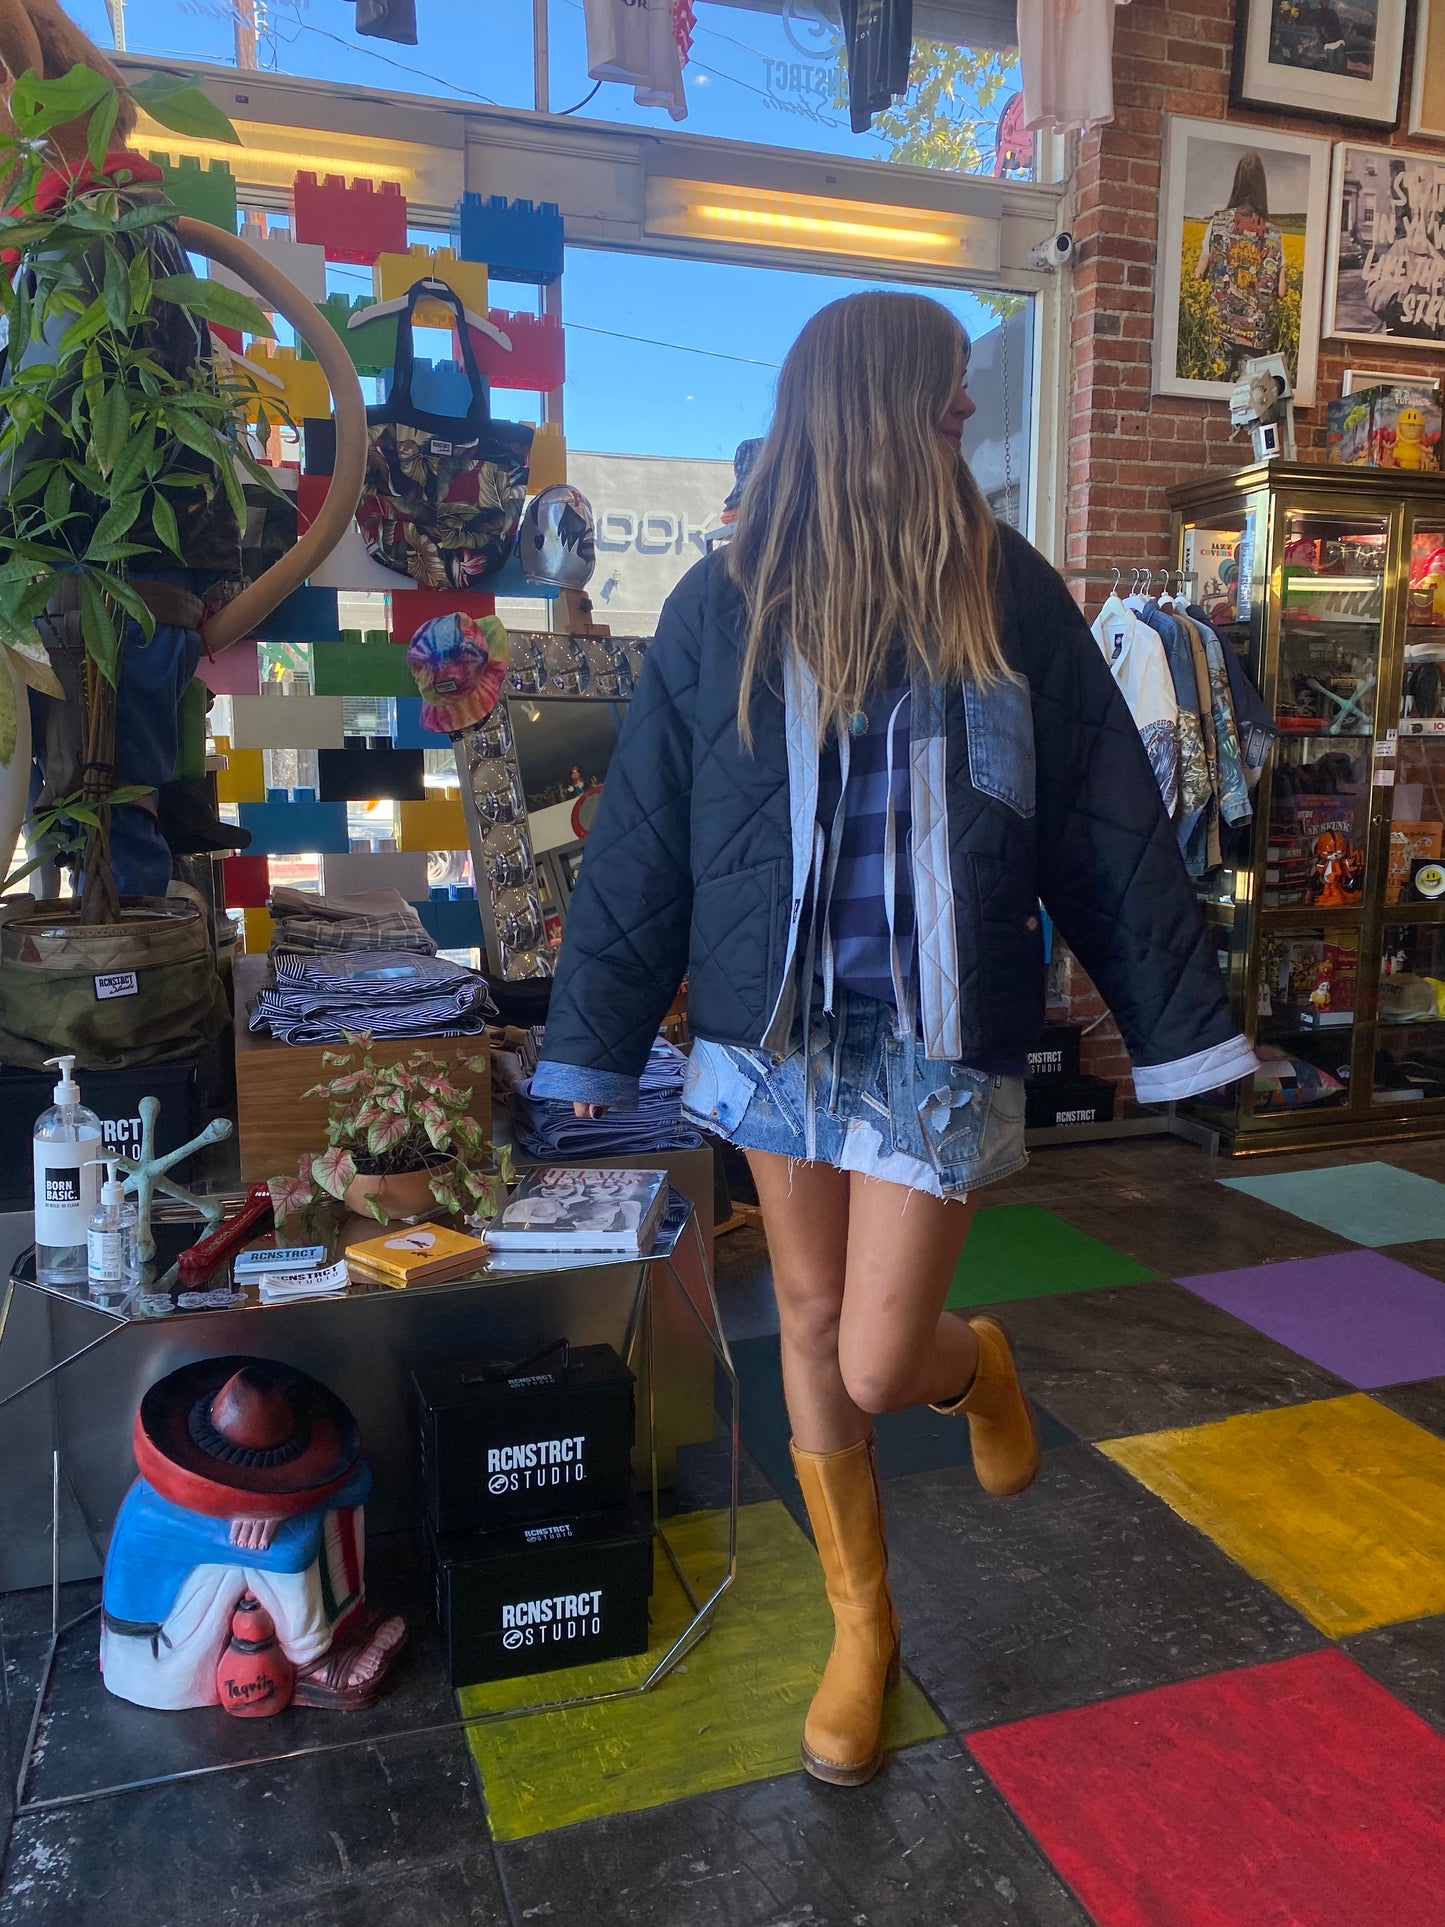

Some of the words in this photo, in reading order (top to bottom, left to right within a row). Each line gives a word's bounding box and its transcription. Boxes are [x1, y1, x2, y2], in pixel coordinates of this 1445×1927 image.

[592, 508, 718, 544] OOK
[98, 974, 133, 988] RCNSTRCT
[1027, 1050, 1063, 1065] CNSTRCT
[1030, 1063, 1062, 1074] STUDIO
[1055, 1108, 1097, 1124] RCNSTRCT
[100, 1118, 141, 1142] RCT
[46, 1180, 73, 1191] BORN
[46, 1190, 78, 1201] BASIC.
[250, 1248, 317, 1261] RCNSTRCT
[507, 1373, 553, 1385] RCNSTRCT
[487, 1436, 586, 1473] RCNSTRCT
[510, 1463, 584, 1491] STUDIO
[524, 1524, 571, 1538] RCNSTRCT
[536, 1531, 573, 1542] STUDIO
[502, 1590, 602, 1629] RCNSTRCT
[525, 1617, 601, 1646] STUDIO
